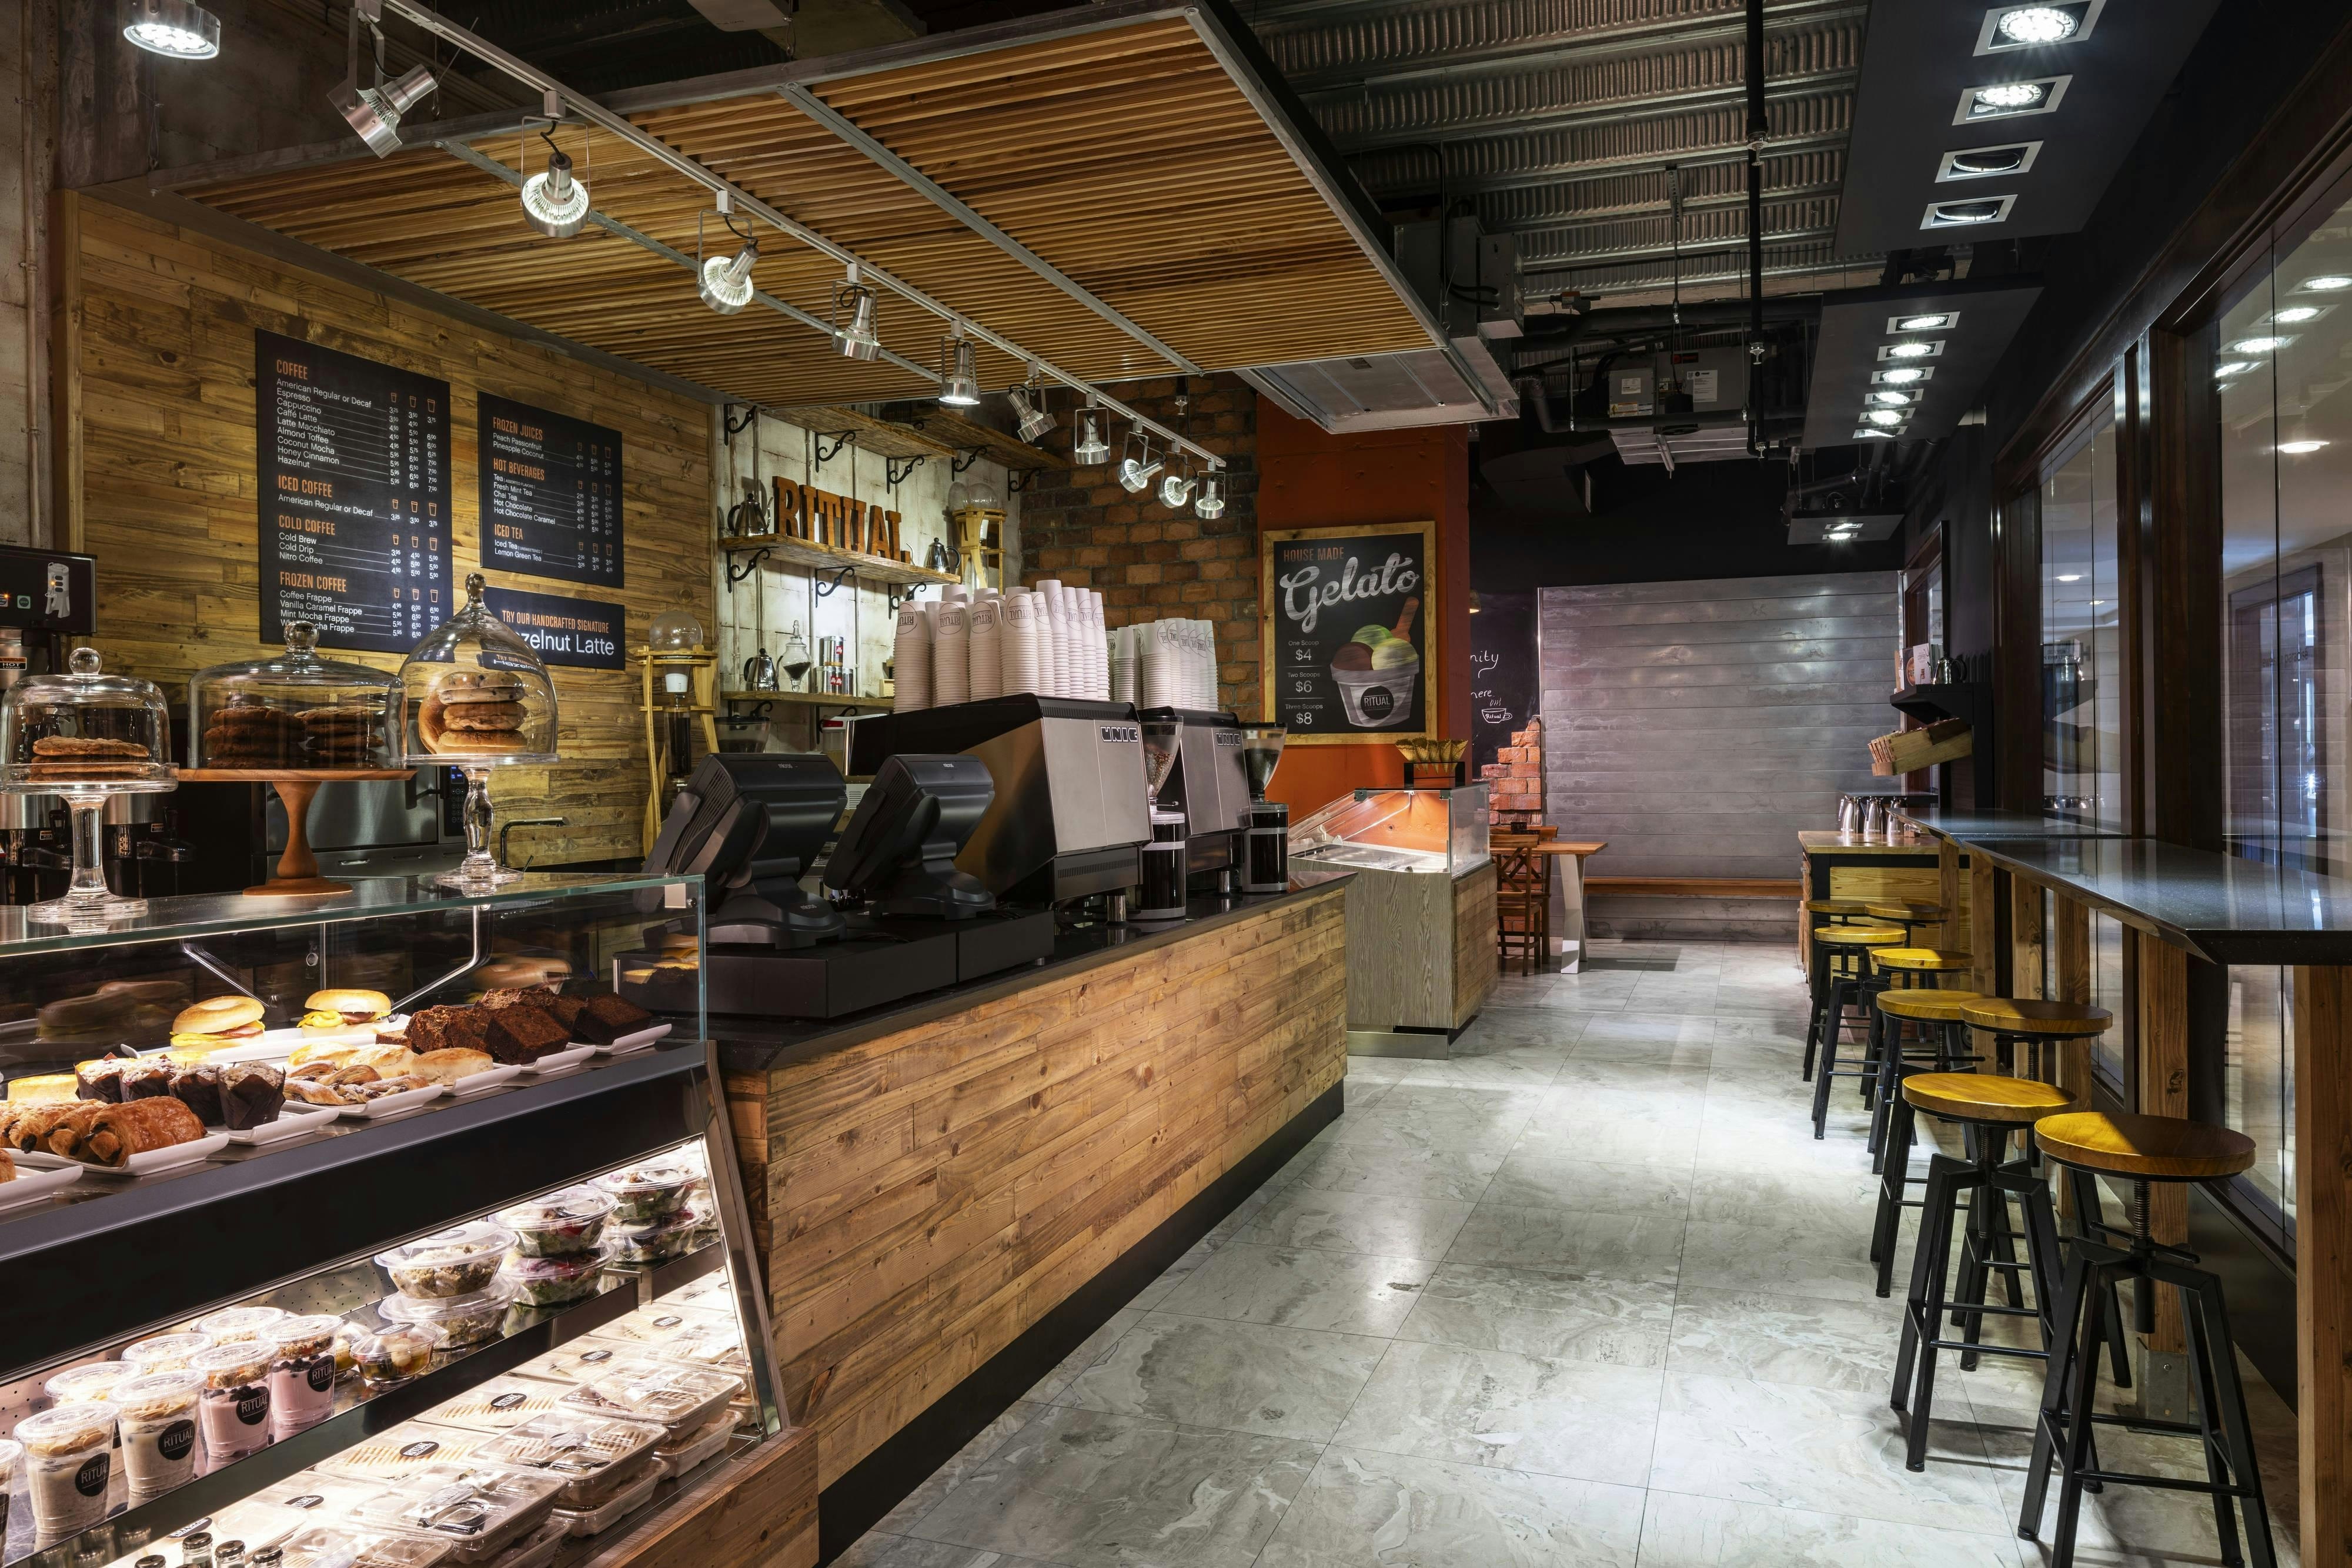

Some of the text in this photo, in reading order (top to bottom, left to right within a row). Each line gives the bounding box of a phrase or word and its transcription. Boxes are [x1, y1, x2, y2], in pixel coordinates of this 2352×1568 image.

[277, 359, 308, 380] COFFEE
[277, 378, 311, 393] American
[313, 387, 340, 401] Regular
[352, 397, 371, 408] Decaf
[277, 388, 310, 402] Espresso
[277, 397, 321, 414] Cappuccino
[277, 407, 297, 418] Caffé
[299, 411, 317, 423] Latte
[277, 416, 296, 428] Latte
[298, 421, 335, 436] Macchiato
[493, 416, 542, 440] FROZEN JUICES
[277, 426, 305, 439] Almond
[308, 433, 329, 444] Toffee
[493, 433, 542, 451] Peach Passionfruit
[277, 436, 308, 450] Coconut
[311, 443, 334, 455] Mocha
[493, 441, 544, 459] Pineapple Coconut
[278, 446, 301, 458] Honey
[304, 451, 339, 465] Cinnamon
[278, 456, 310, 468] Hazelnut
[494, 458, 544, 480] HOT BEVERAGES
[494, 473, 503, 482] Tea
[278, 475, 332, 498] ICED COFFEE
[494, 481, 509, 491] Fresh
[511, 485, 522, 494] Mint
[494, 490, 507, 499] Chai
[278, 494, 313, 507] American
[315, 500, 342, 512] Regular
[353, 507, 373, 517] Decaf
[494, 499, 532, 512] Hot Chocolate
[494, 507, 555, 525] Hot Chocolate Caramel
[772, 476, 910, 564] RITUAL
[279, 515, 335, 535] COLD COFFEE
[495, 524, 523, 540] ICED TEA
[279, 532, 296, 542] Cold
[299, 535, 316, 545] Brew
[279, 542, 296, 551] Cold
[299, 545, 314, 554] Drip
[495, 548, 513, 557] Lemon
[515, 551, 531, 560] Green
[1284, 547, 1344, 562] HOUSE MADE
[280, 552, 297, 561] Nitro
[299, 554, 323, 564] Coffee
[280, 572, 346, 592] FROZEN COFFEE
[280, 590, 304, 600] Coffee
[307, 593, 332, 604] Frappe
[1280, 553, 1420, 633] Gelato
[280, 600, 304, 609] Vanilla
[306, 602, 336, 613] Caramel
[338, 606, 362, 617] Frappe
[281, 609, 296, 618] Mint
[299, 611, 322, 621] Mocha
[325, 614, 349, 624] Frappe
[330, 623, 354, 633] Frappe
[502, 610, 609, 633] TRY OUR HANDCRAFTED SIGNATURE
[514, 629, 614, 655] zelnut Latte
[1296, 649, 1311, 661] $4
[1296, 681, 1312, 693] $6
[1364, 696, 1390, 706] RITUAL
[1296, 712, 1312, 725] $8
[1101, 726, 1138, 742] UNIC
[1215, 733, 1241, 746] UNIC
[241, 1394, 268, 1413] RITUAL
[164, 1428, 193, 1447] RITUAL
